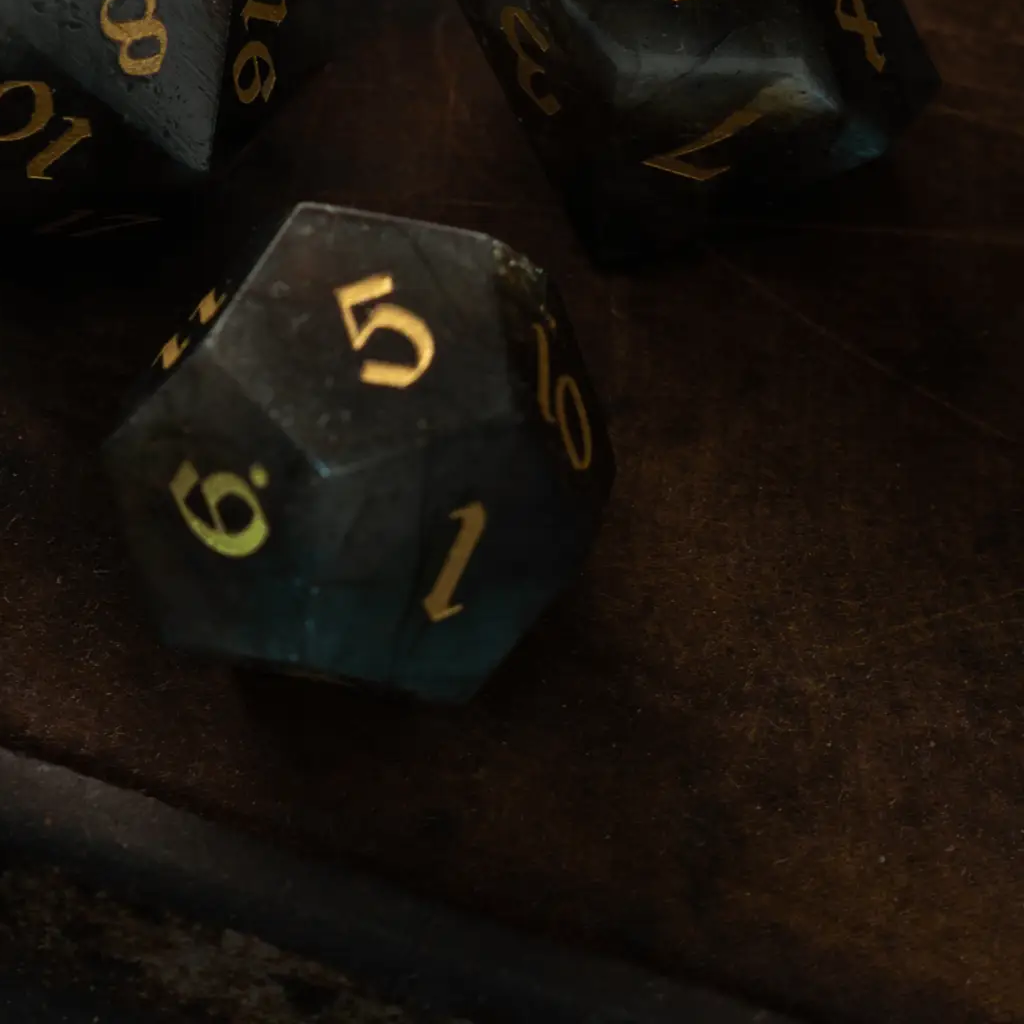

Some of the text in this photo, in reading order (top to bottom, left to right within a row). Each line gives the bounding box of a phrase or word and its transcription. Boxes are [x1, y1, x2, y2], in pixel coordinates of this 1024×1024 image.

[499, 5, 561, 117] 3
[334, 273, 435, 388] 5
[532, 310, 592, 471] 10
[421, 500, 488, 622] 1
